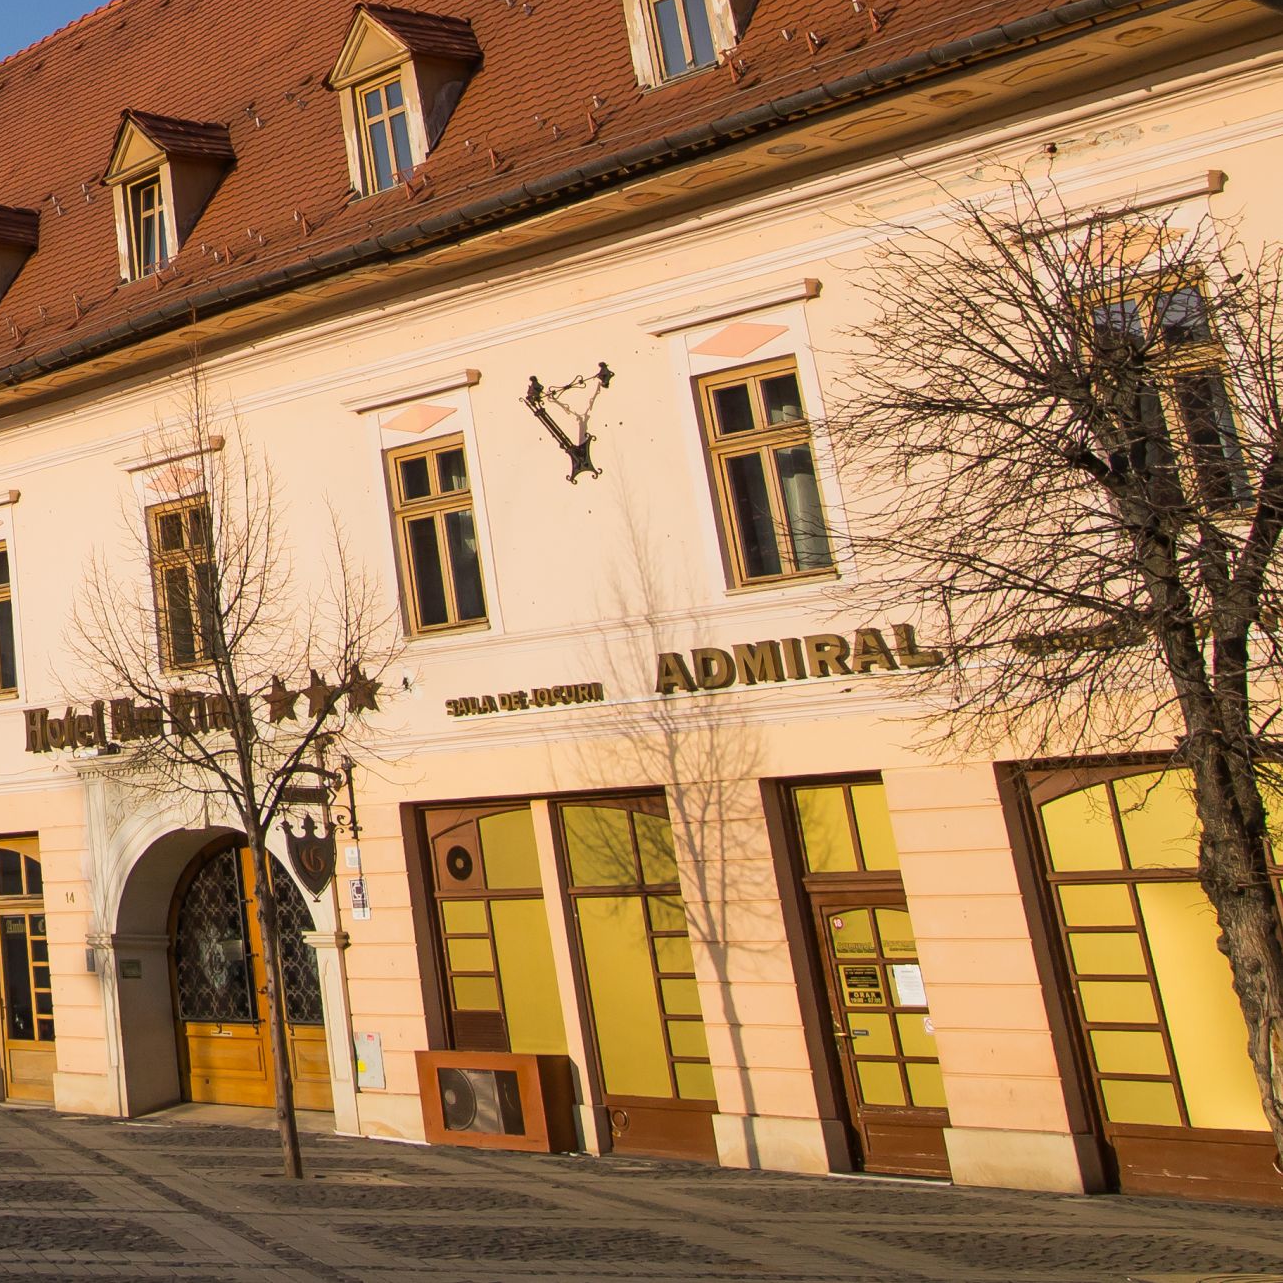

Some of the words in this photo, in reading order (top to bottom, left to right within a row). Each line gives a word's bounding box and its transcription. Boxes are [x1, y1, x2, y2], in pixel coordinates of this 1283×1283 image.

[655, 622, 947, 694] ADMIRAL
[445, 695, 499, 717] SALA
[498, 690, 529, 711] DE
[529, 682, 604, 708] JOCURI
[23, 699, 107, 754] Hotel
[65, 891, 75, 904] 14
